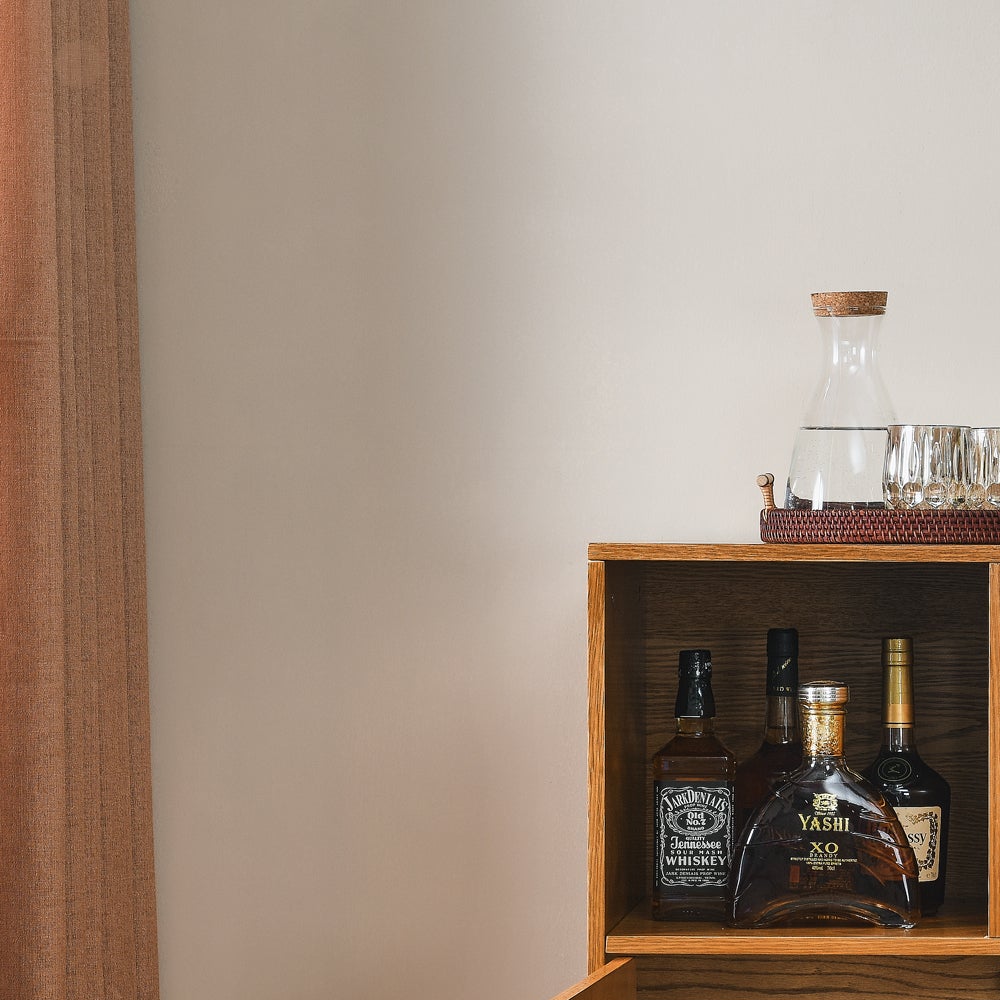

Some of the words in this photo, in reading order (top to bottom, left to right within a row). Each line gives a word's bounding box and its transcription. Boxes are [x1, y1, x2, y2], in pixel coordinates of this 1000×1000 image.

[687, 811, 705, 819] Old
[685, 818, 707, 826] No.7
[797, 813, 850, 832] YASHI
[809, 841, 839, 854] XO
[665, 855, 727, 866] WHISKEY
